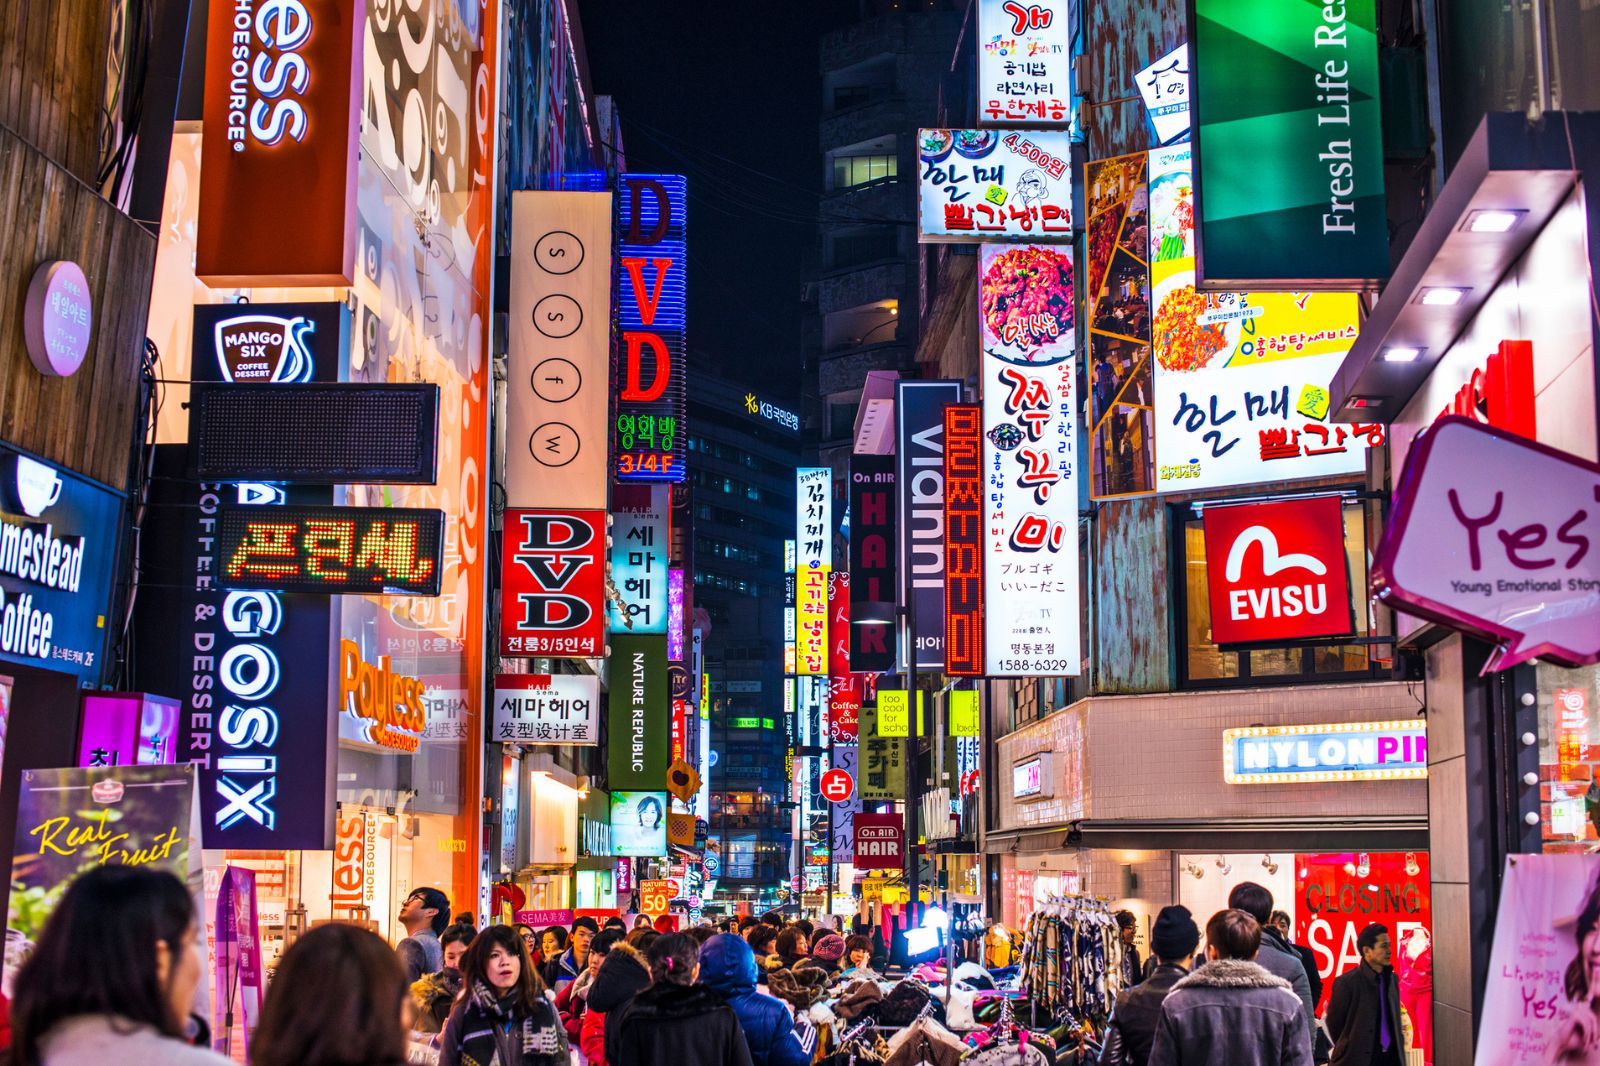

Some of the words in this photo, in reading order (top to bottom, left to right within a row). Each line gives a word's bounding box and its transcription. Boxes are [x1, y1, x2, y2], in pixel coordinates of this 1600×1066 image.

[1314, 0, 1347, 48] Re
[1003, 60, 1046, 76] 공기밥
[996, 81, 1053, 96] 라면사리
[1314, 60, 1350, 127] Life
[985, 99, 1067, 120] 무한제공
[1003, 133, 1068, 181] 4,500원
[923, 160, 1005, 203] 할매
[1319, 138, 1356, 236] Fresh
[620, 178, 673, 402] DVD
[225, 332, 282, 347] MANGO
[240, 345, 266, 358] SIX
[234, 370, 270, 378] DESSERT
[237, 363, 269, 371] COFFEE
[617, 415, 676, 450] 영화방
[1172, 385, 1290, 458] 할매
[1057, 403, 1072, 480] 무한리필
[853, 473, 870, 483] On
[875, 473, 895, 483] AIR
[804, 483, 824, 559] 김치찌개
[991, 512, 1004, 552] 서비스
[0, 518, 86, 593] mestead
[513, 514, 595, 631] DVD
[624, 526, 656, 625] 세마헤어
[861, 492, 888, 654] HAIR
[1000, 563, 1055, 575] ブルゴギ
[1451, 579, 1493, 596] Young
[1497, 578, 1562, 593] Emotional
[194, 604, 216, 622] &
[1229, 584, 1327, 621] EVISU
[508, 636, 595, 653] 전룸3/5인석
[1011, 643, 1055, 655] 명동본점
[998, 659, 1068, 671] 1588-6329
[631, 652, 645, 705] NATURE
[190, 632, 215, 770] DESSERT
[340, 638, 427, 743] Payless
[884, 695, 900, 703] too
[500, 697, 590, 720] 세마헤어
[831, 702, 859, 710] Coffee
[883, 704, 905, 712] cool
[883, 724, 908, 732] scho
[884, 714, 897, 722] for
[500, 721, 589, 740] 发型设计室
[631, 709, 645, 772] REPUBLIC
[1243, 739, 1375, 769] NYLON
[827, 775, 847, 795] 占
[30, 808, 111, 856] Real
[861, 828, 875, 837] On
[878, 828, 895, 837] AIR
[99, 826, 182, 866] Fruit
[857, 841, 899, 856] HAIR
[643, 895, 666, 912] 50
[1306, 883, 1421, 915] CLOSING
